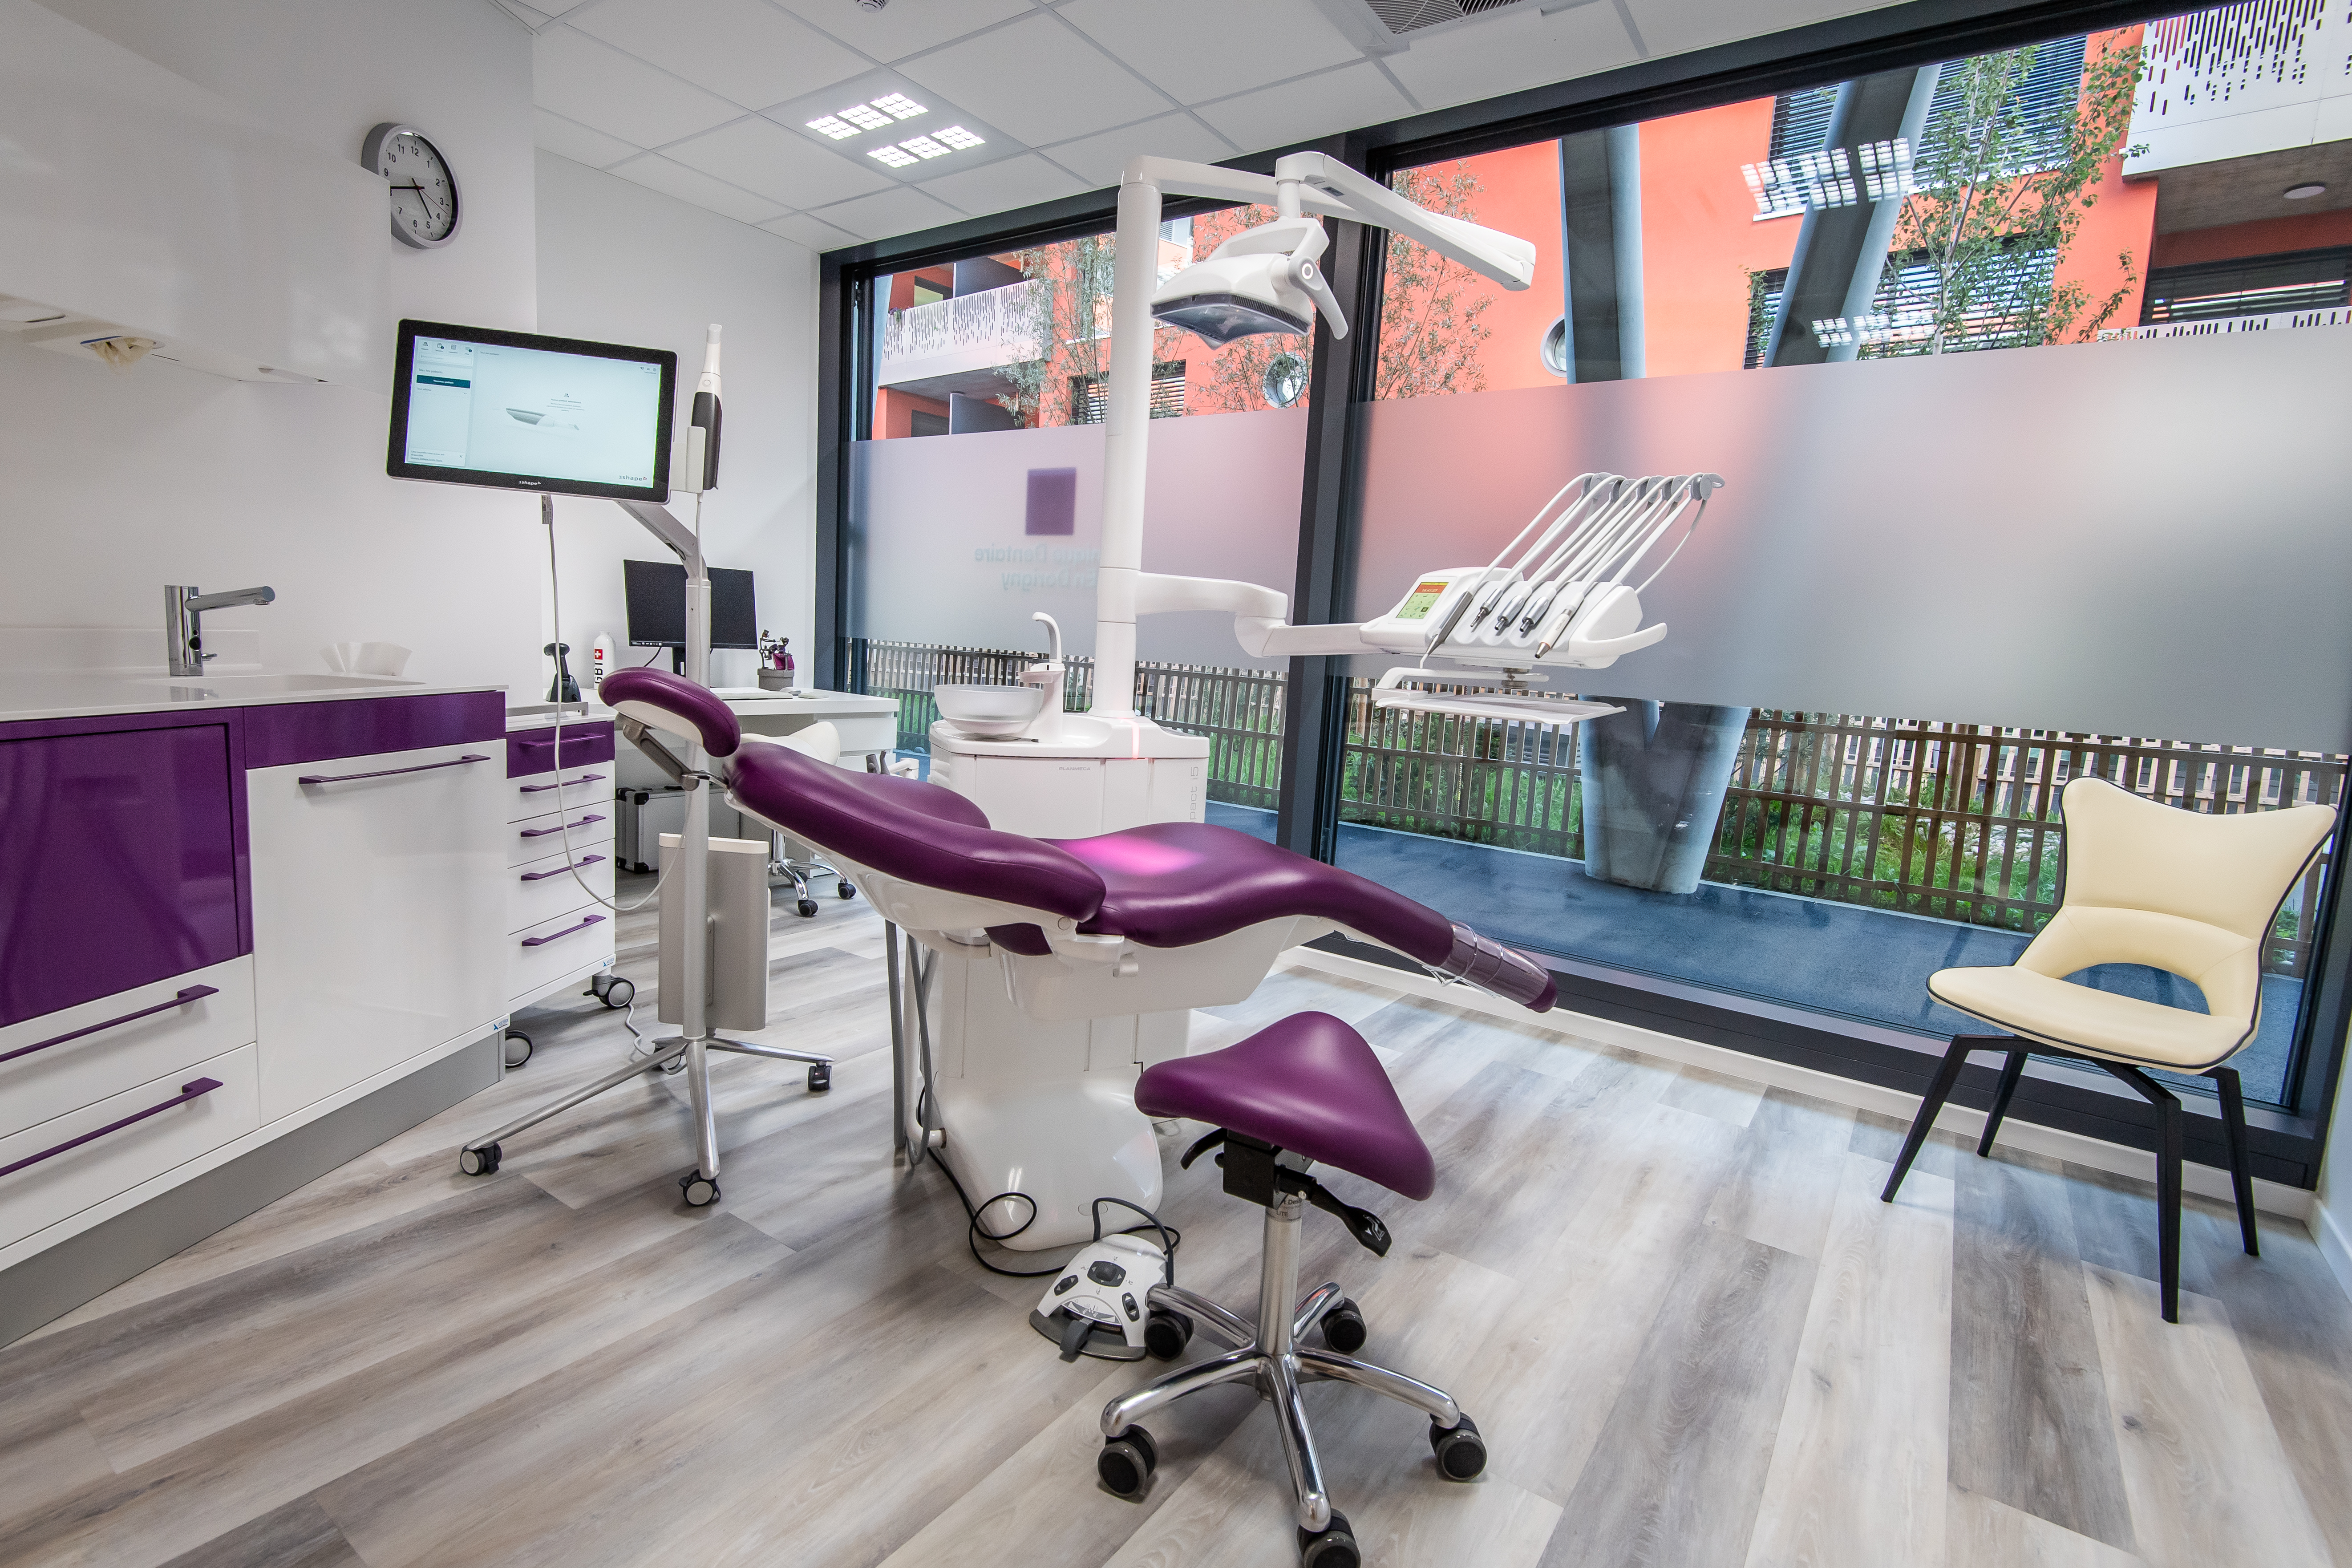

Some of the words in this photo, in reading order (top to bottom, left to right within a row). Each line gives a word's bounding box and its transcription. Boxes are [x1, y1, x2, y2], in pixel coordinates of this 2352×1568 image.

[397, 144, 405, 154] 11
[411, 146, 419, 157] 12
[388, 152, 396, 163] 10
[384, 168, 389, 177] 9
[436, 178, 441, 186] 2
[440, 197, 444, 205] 3
[398, 207, 403, 215] 7
[413, 219, 417, 228] 6
[426, 221, 431, 229] 5
[594, 660, 603, 684] GBT
